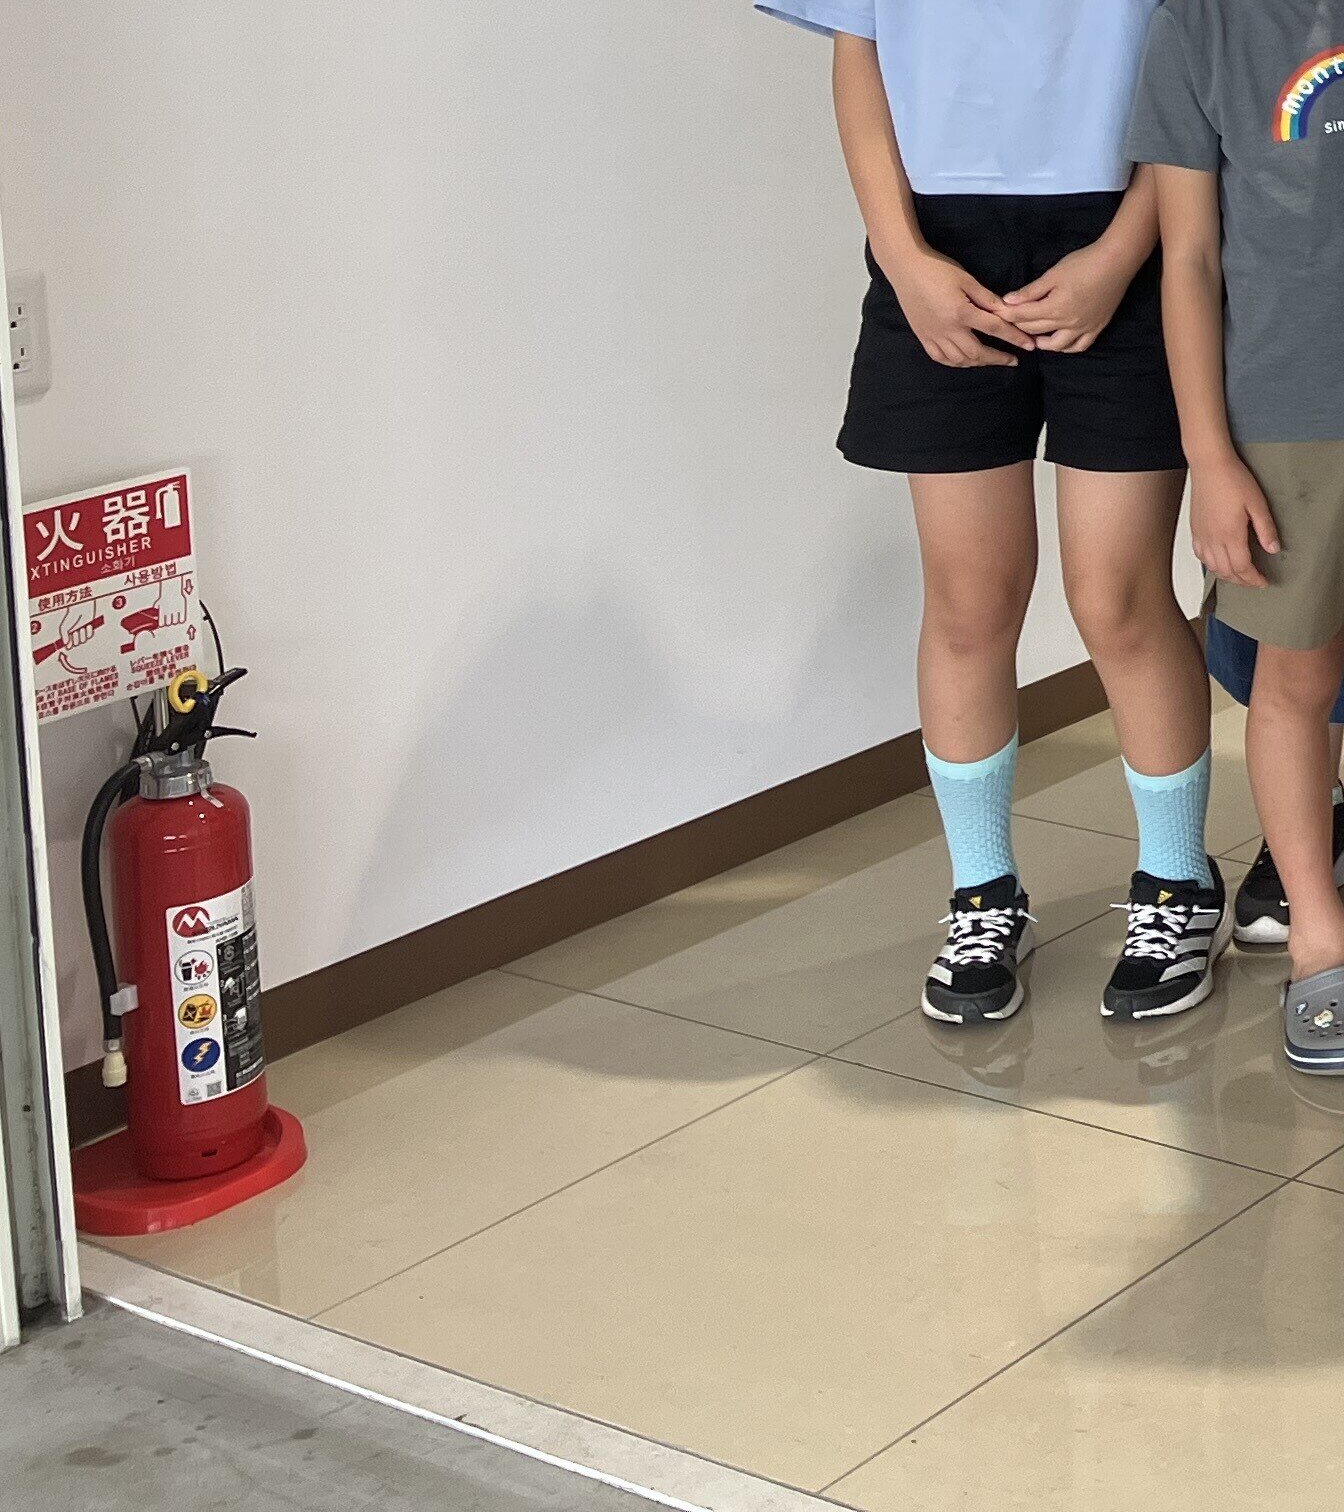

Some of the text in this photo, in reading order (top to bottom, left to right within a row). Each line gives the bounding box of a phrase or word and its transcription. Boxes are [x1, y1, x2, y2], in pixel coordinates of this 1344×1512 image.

[30, 537, 152, 581] XTINGUISHER
[38, 586, 93, 611] 使用方法
